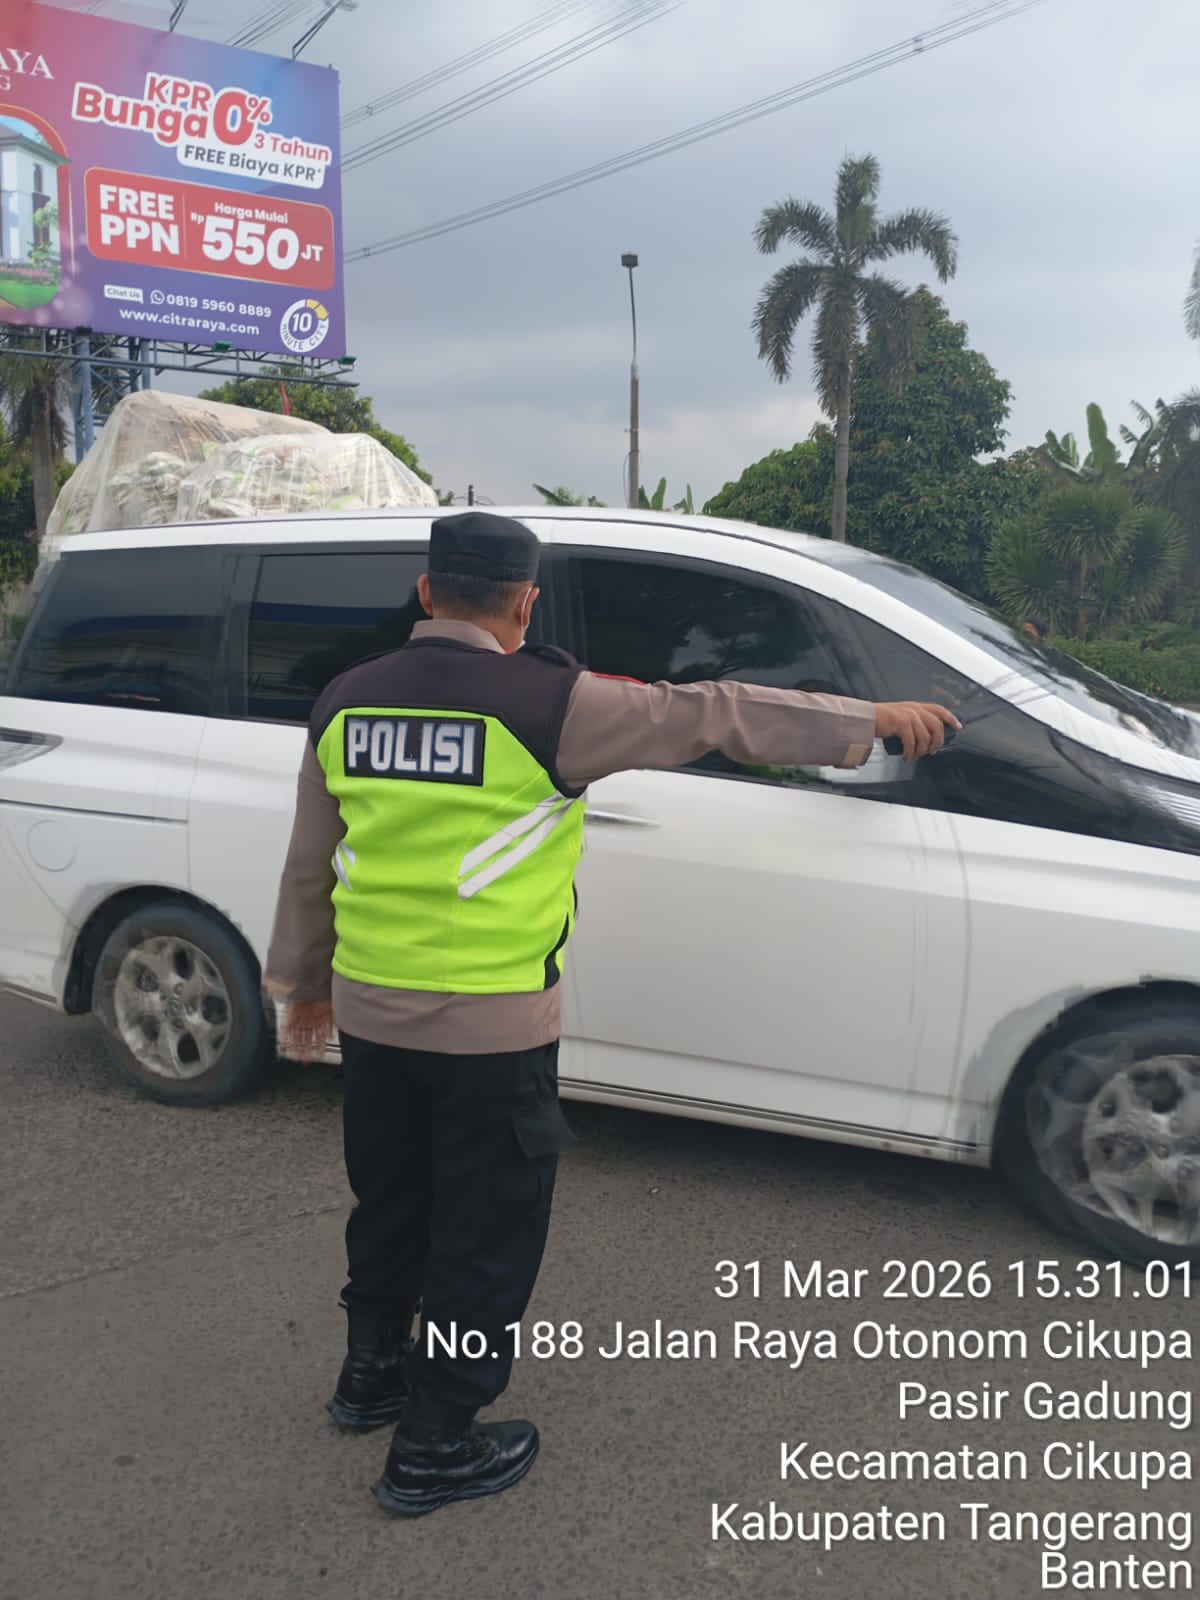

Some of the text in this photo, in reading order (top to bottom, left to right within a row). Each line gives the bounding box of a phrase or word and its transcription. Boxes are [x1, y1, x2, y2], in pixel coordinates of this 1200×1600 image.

[147, 76, 212, 111] KPR
[75, 87, 209, 143] Bunga
[184, 145, 226, 165] FREE
[229, 153, 279, 176] Biaya
[254, 133, 329, 162] 3 Tahun
[100, 184, 175, 221] FREE
[214, 202, 288, 224] Harga Mulai
[100, 215, 180, 255] PPN
[190, 212, 323, 270] Rp 550 JT
[119, 309, 260, 335] www.citraraya.com
[166, 294, 272, 318] 0819 5960 8889
[292, 312, 312, 332] 10
[347, 719, 475, 775] POLISI
